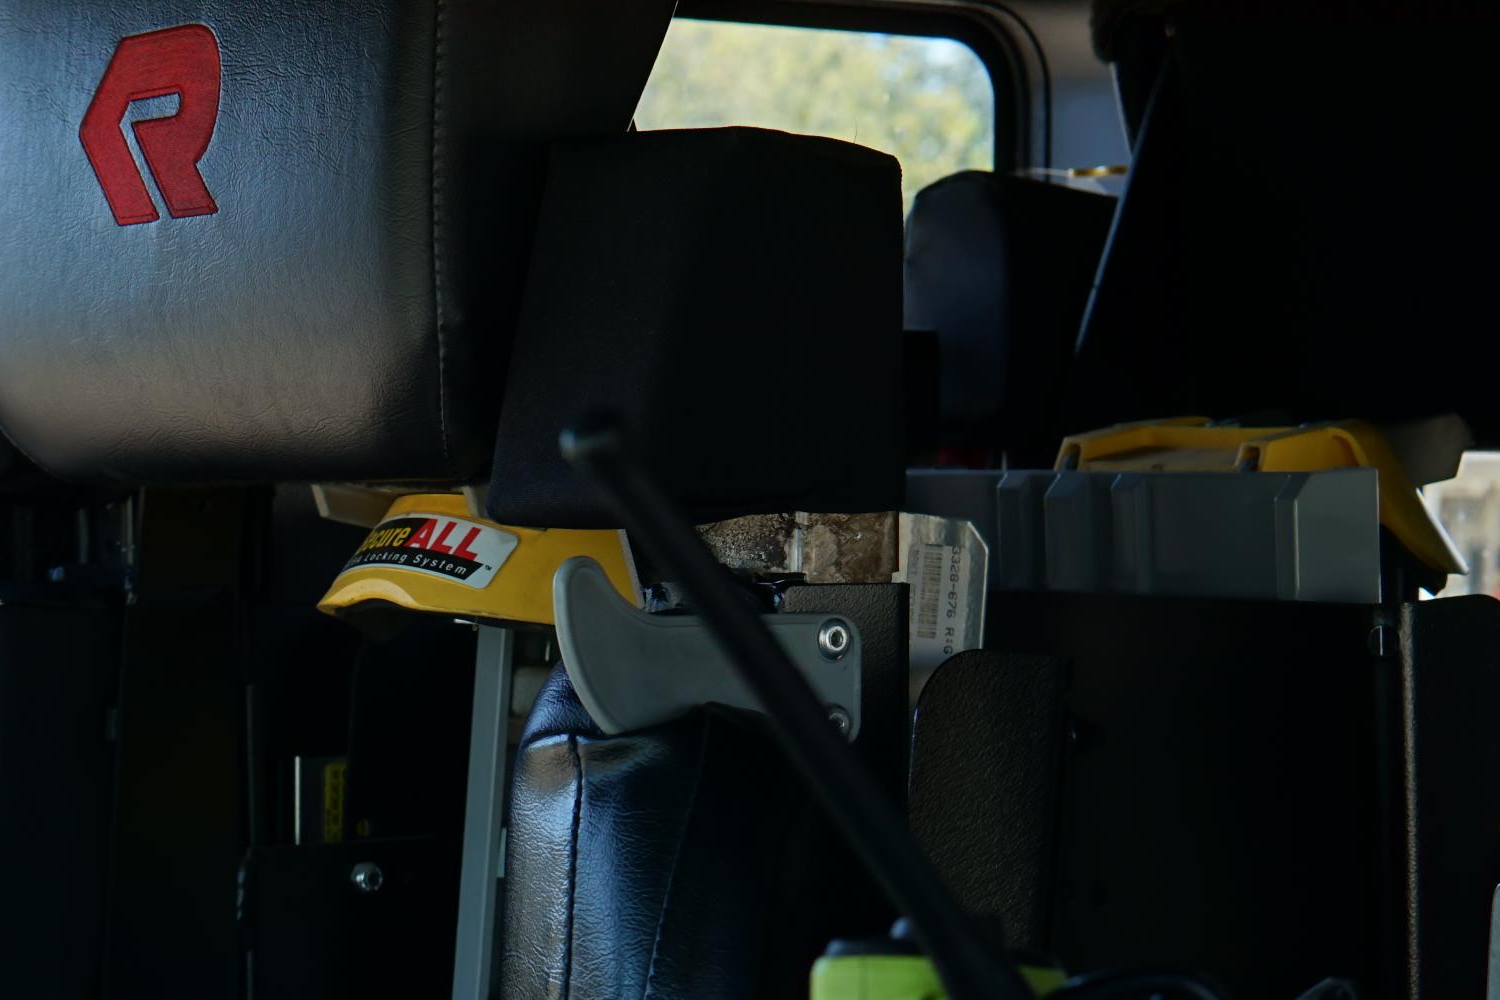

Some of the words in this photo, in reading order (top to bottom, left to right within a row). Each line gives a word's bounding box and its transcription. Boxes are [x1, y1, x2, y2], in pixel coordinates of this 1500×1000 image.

[78, 23, 221, 226] R
[364, 551, 408, 565] Locking
[412, 553, 467, 575] System
